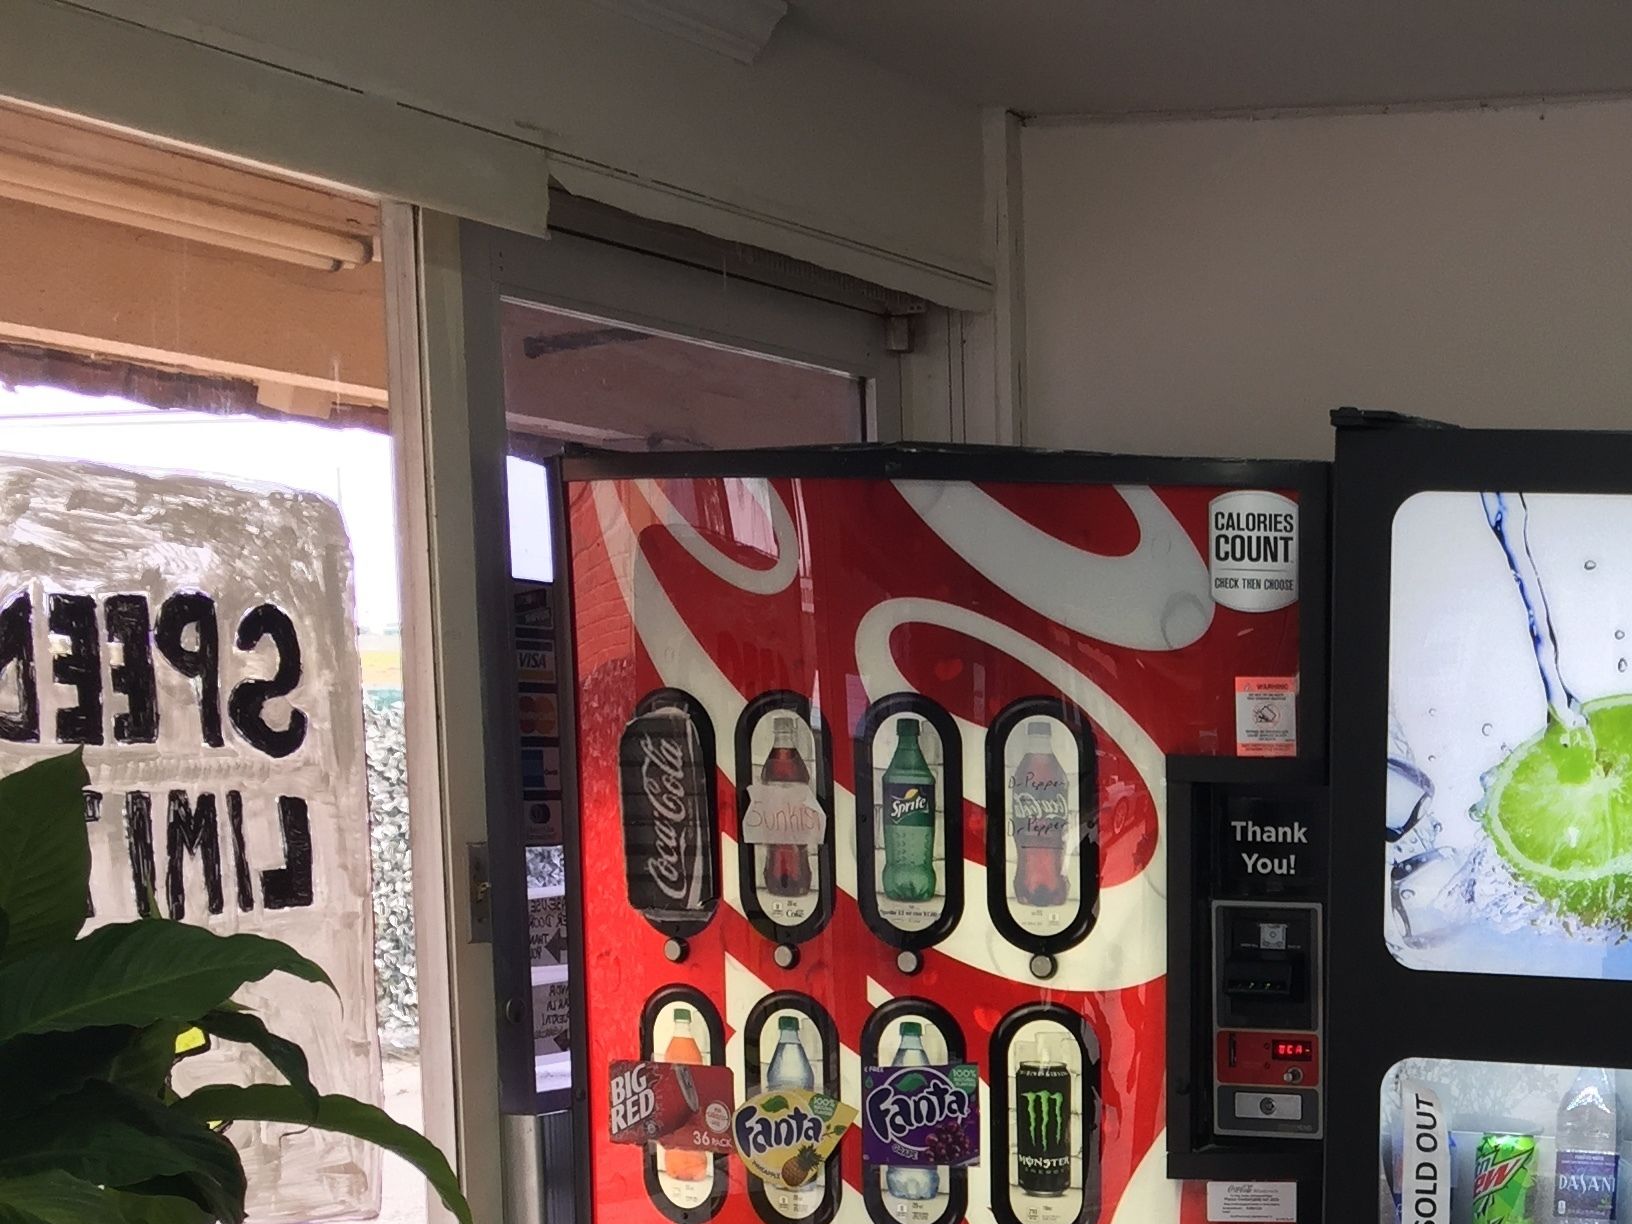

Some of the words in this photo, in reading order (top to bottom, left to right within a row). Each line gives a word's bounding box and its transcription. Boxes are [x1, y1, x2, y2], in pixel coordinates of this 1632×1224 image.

[1214, 512, 1294, 533] CALORIES
[1214, 534, 1293, 563] COUNT
[1214, 577, 1239, 589] CHECK
[1243, 578, 1261, 590] THEN
[1264, 578, 1294, 591] CHOOSE
[519, 652, 547, 668] VISA
[891, 796, 928, 818] Sprite
[1027, 818, 1069, 836] Pepper
[1231, 821, 1308, 843] Thank
[1242, 853, 1296, 875] You!
[611, 1064, 647, 1102] BIG
[953, 1069, 976, 1077] 100%
[611, 1088, 655, 1134] RED
[867, 1080, 968, 1143] Fanta
[736, 1106, 822, 1158] Fanta
[1416, 1093, 1437, 1152] OUT
[693, 1131, 710, 1145] 36
[712, 1138, 732, 1147] PACK
[1019, 1154, 1069, 1168] MONSTER
[1559, 1174, 1615, 1193] DASANI
